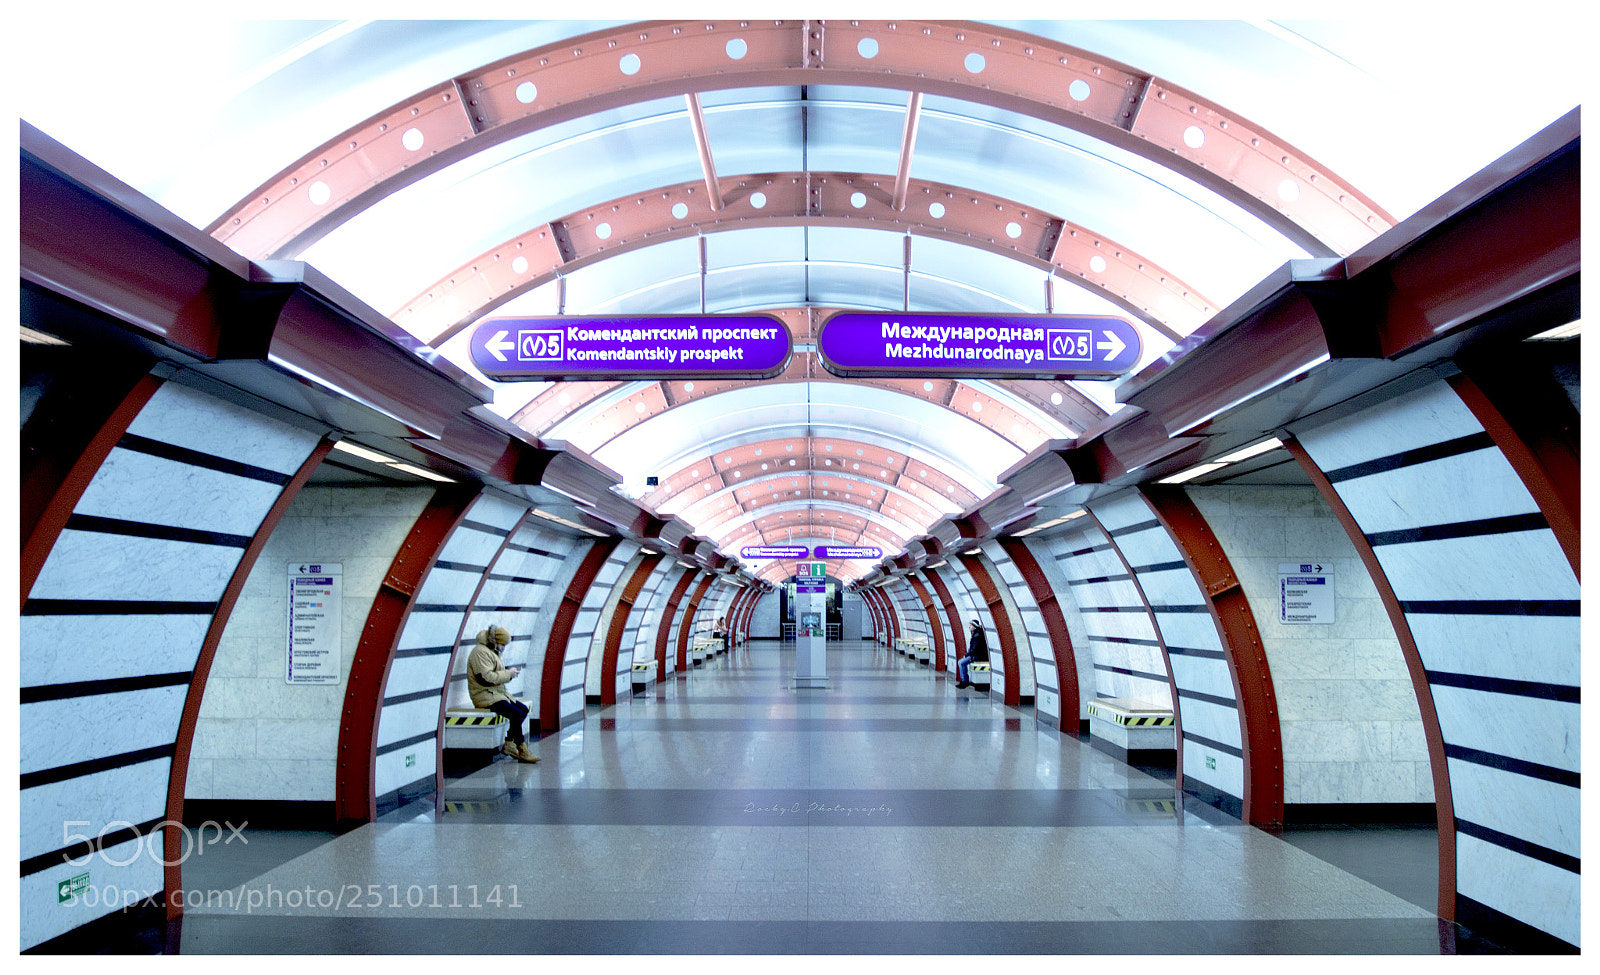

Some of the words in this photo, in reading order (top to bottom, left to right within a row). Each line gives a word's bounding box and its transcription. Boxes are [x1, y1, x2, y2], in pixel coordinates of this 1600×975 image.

[567, 325, 699, 342] Комендантский
[702, 328, 778, 343] проспект
[881, 322, 1044, 343] Международная
[566, 346, 678, 363] Komendantskiy
[680, 346, 744, 363] prospekt
[885, 343, 1045, 363] Mezhdunarodnaya
